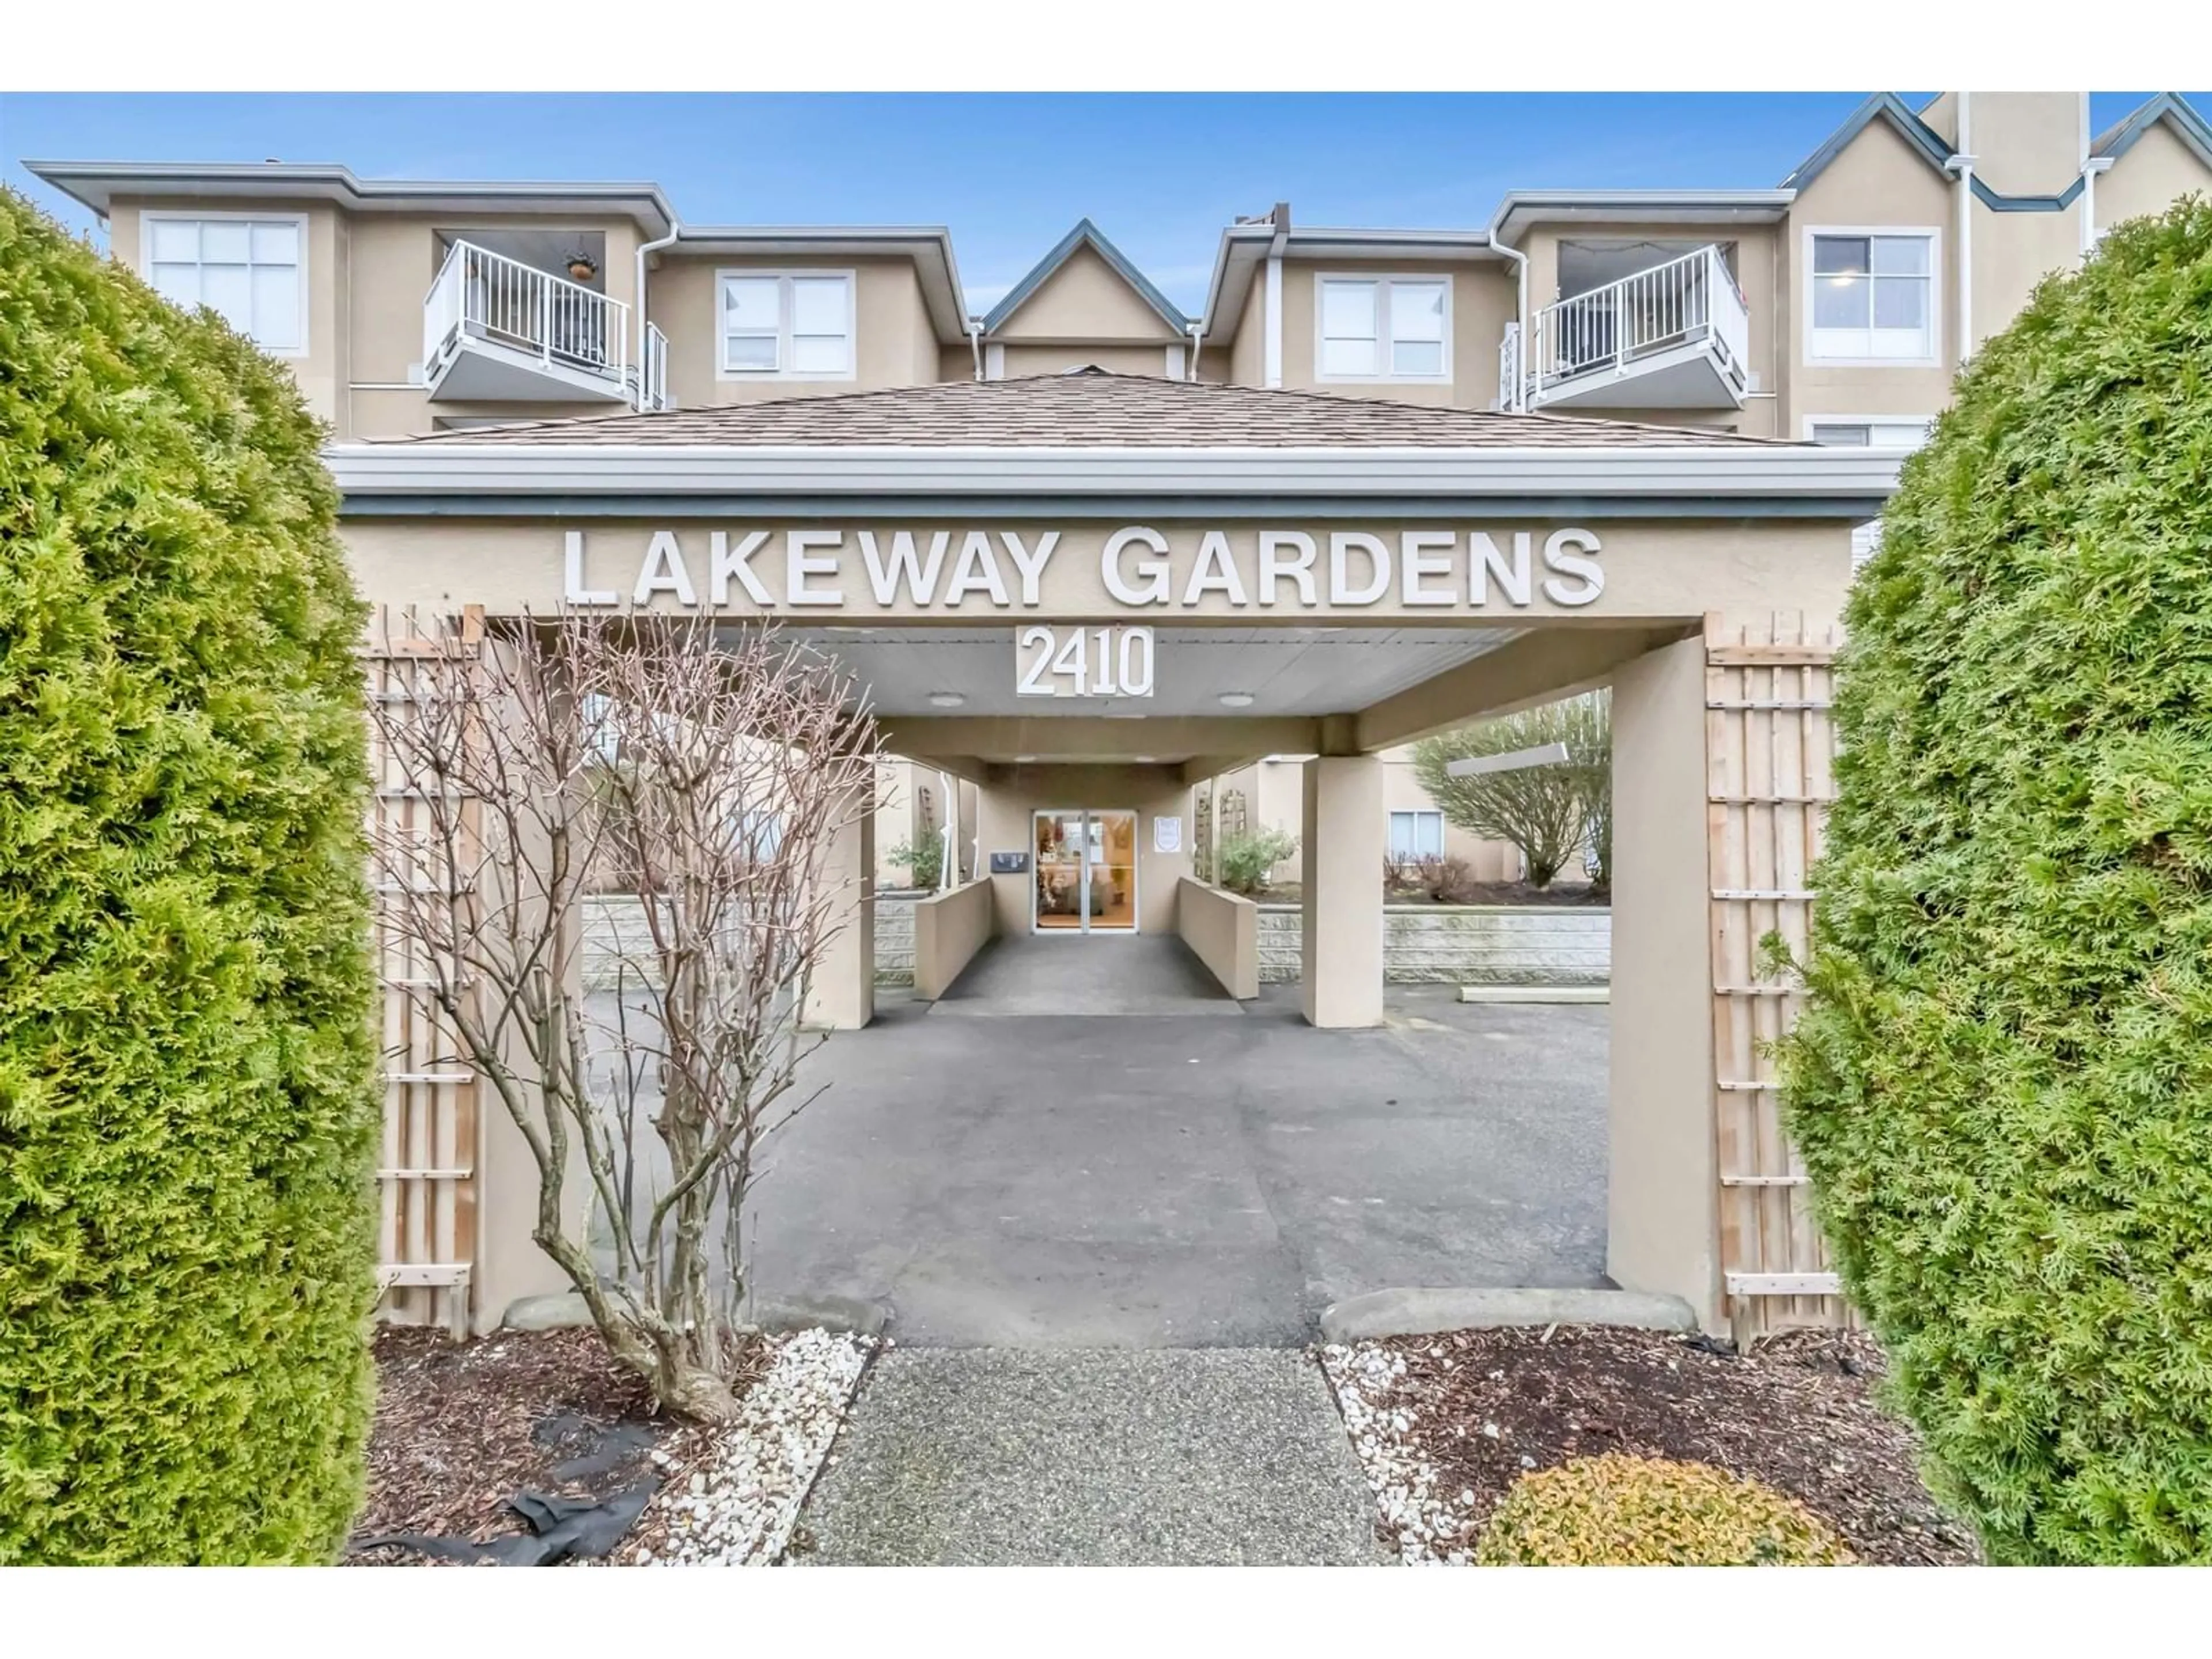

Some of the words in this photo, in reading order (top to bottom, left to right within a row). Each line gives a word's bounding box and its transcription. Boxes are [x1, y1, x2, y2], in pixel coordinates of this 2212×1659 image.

[565, 531, 1061, 607] LAKEWAY
[1101, 526, 1605, 608] GARDENS
[1017, 626, 1153, 696] 2410
